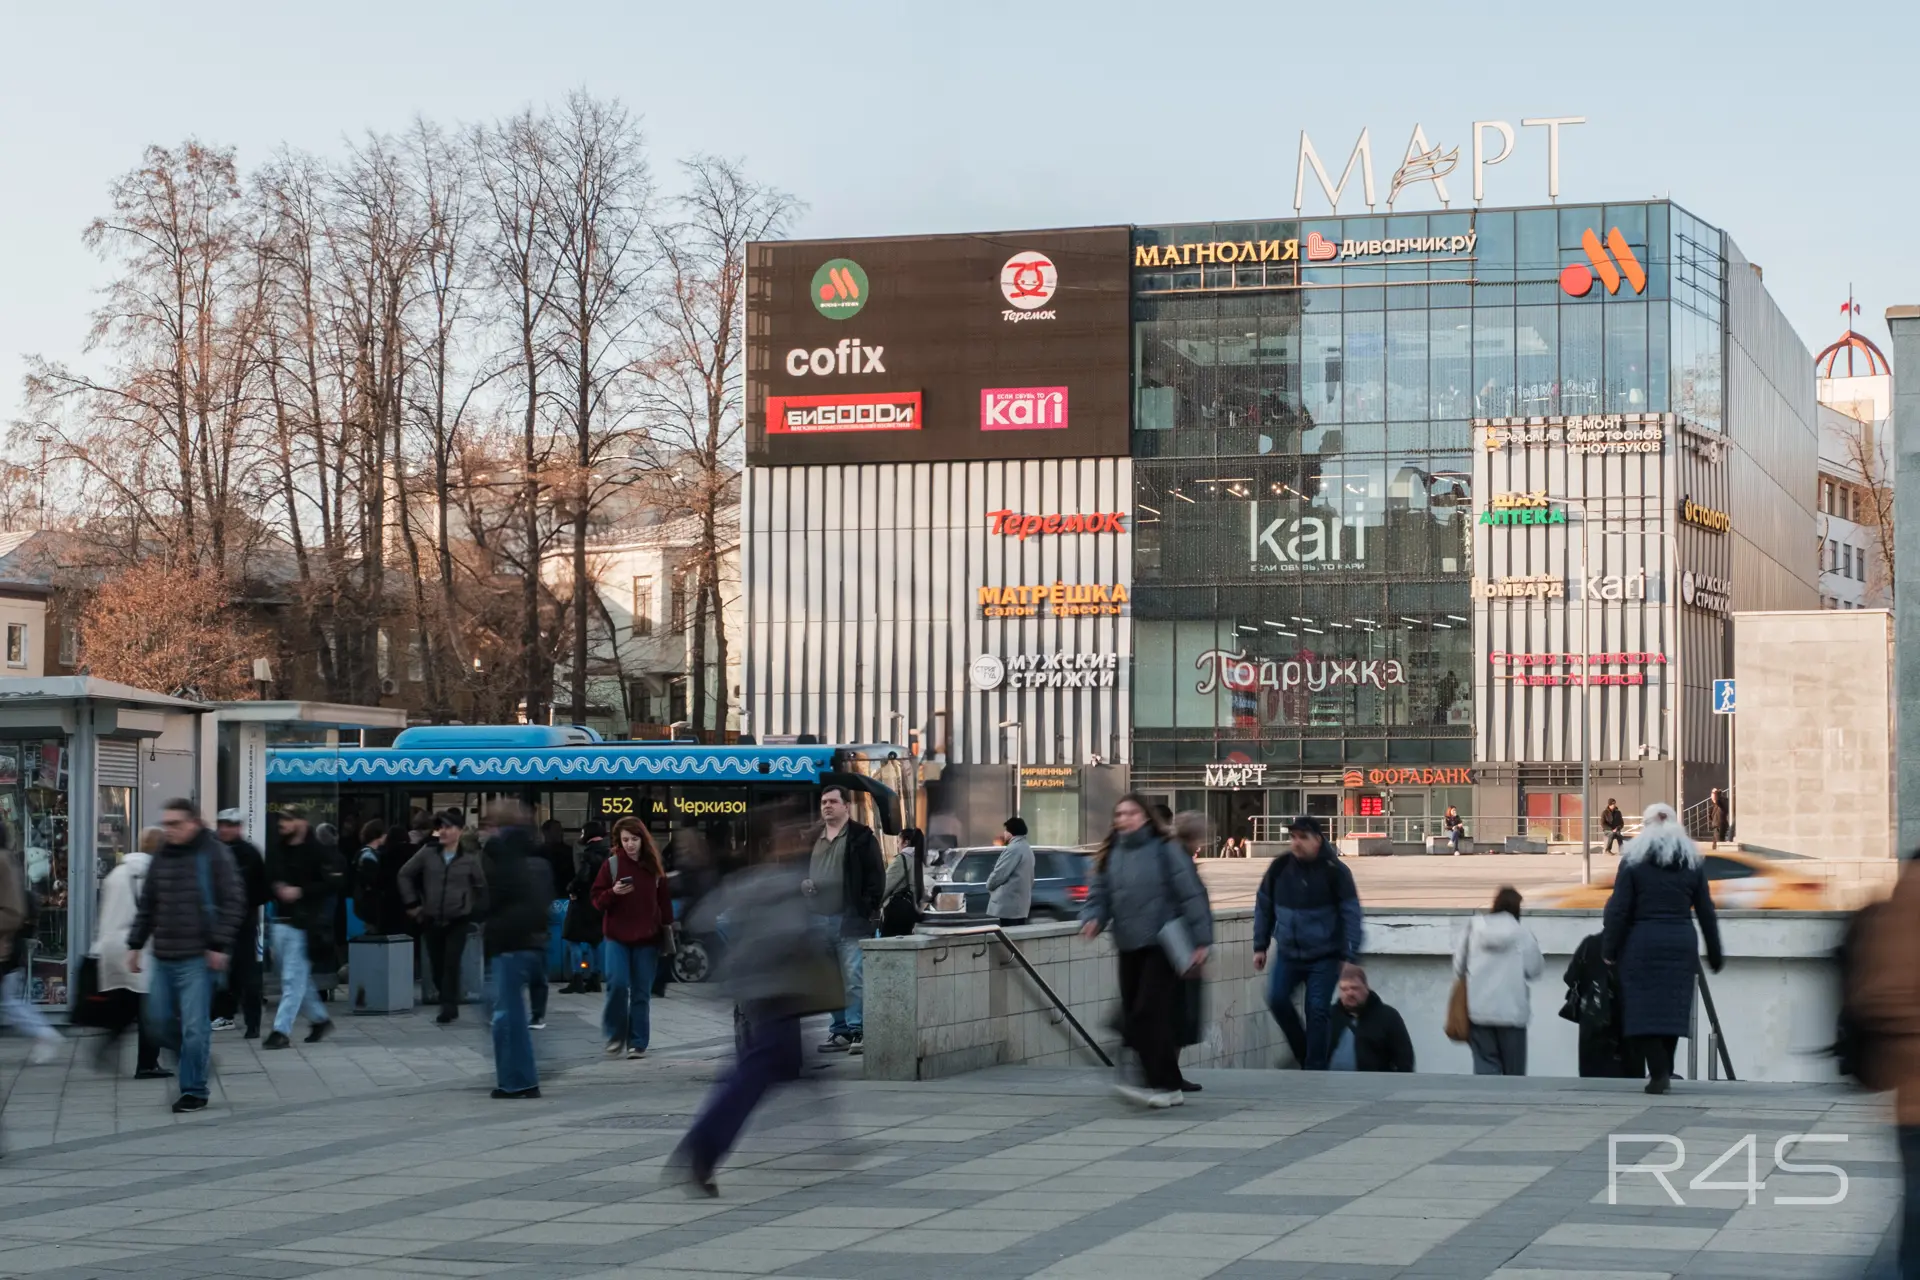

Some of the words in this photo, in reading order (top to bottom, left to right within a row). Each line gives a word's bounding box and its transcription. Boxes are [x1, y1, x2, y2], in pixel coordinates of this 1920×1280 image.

[1294, 116, 1586, 209] МАРТ
[1135, 239, 1299, 267] МАГНОЛИЯ
[1001, 309, 1057, 323] Теремок
[786, 338, 886, 377] cofix
[986, 392, 1063, 425] kari
[1566, 418, 1622, 430] РЕМОНТ
[1566, 429, 1663, 442] СМАРТФОНОВ
[1566, 443, 1577, 454] И
[1582, 441, 1661, 454] НОУТБУКОВ
[985, 509, 1127, 541] Теремок
[1478, 508, 1565, 525] АПТЕКА
[1693, 504, 1731, 533] СТОЛОТО
[1250, 500, 1365, 561] kari
[978, 580, 1129, 605] МАТРЁШКА
[1581, 566, 1645, 601] kari
[1695, 573, 1731, 596] МУЖСКИЕ
[984, 605, 1035, 617] салон
[1051, 603, 1122, 618] красоты
[1695, 591, 1731, 613] СТРИЖКИ
[1007, 652, 1117, 670] МУЖСКИЕ
[1195, 648, 1406, 694] Подружка
[1009, 670, 1114, 688] СТРИЖКИ
[1026, 779, 1064, 787] МАГАЗИН
[1205, 768, 1267, 786] МАРТ
[602, 797, 634, 813] 552
[652, 801, 668, 813] м.
[674, 797, 747, 817] Черкизо
